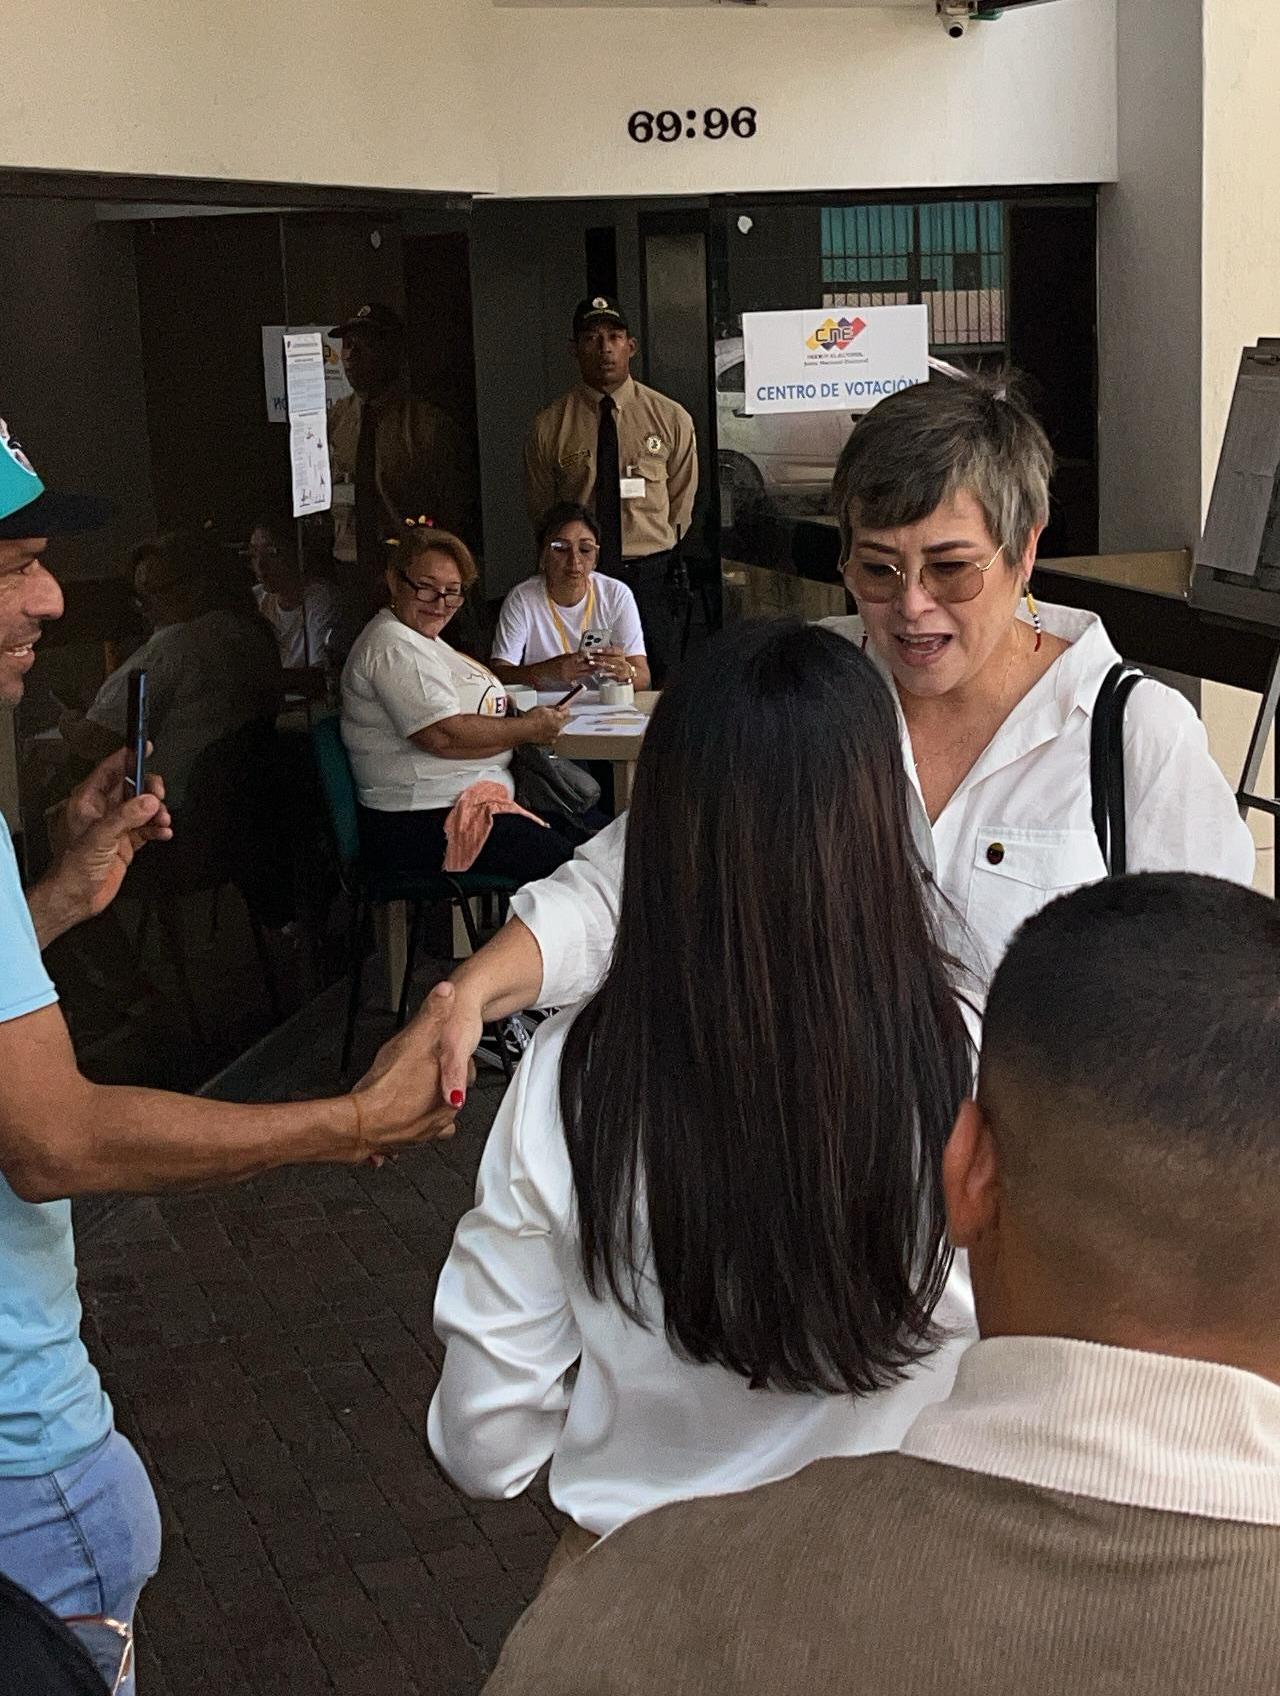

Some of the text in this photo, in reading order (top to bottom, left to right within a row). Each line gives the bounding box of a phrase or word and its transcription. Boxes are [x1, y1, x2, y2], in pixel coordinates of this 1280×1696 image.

[627, 106, 757, 143] 69:96
[756, 384, 817, 401] CENTRO
[820, 383, 839, 398] DE
